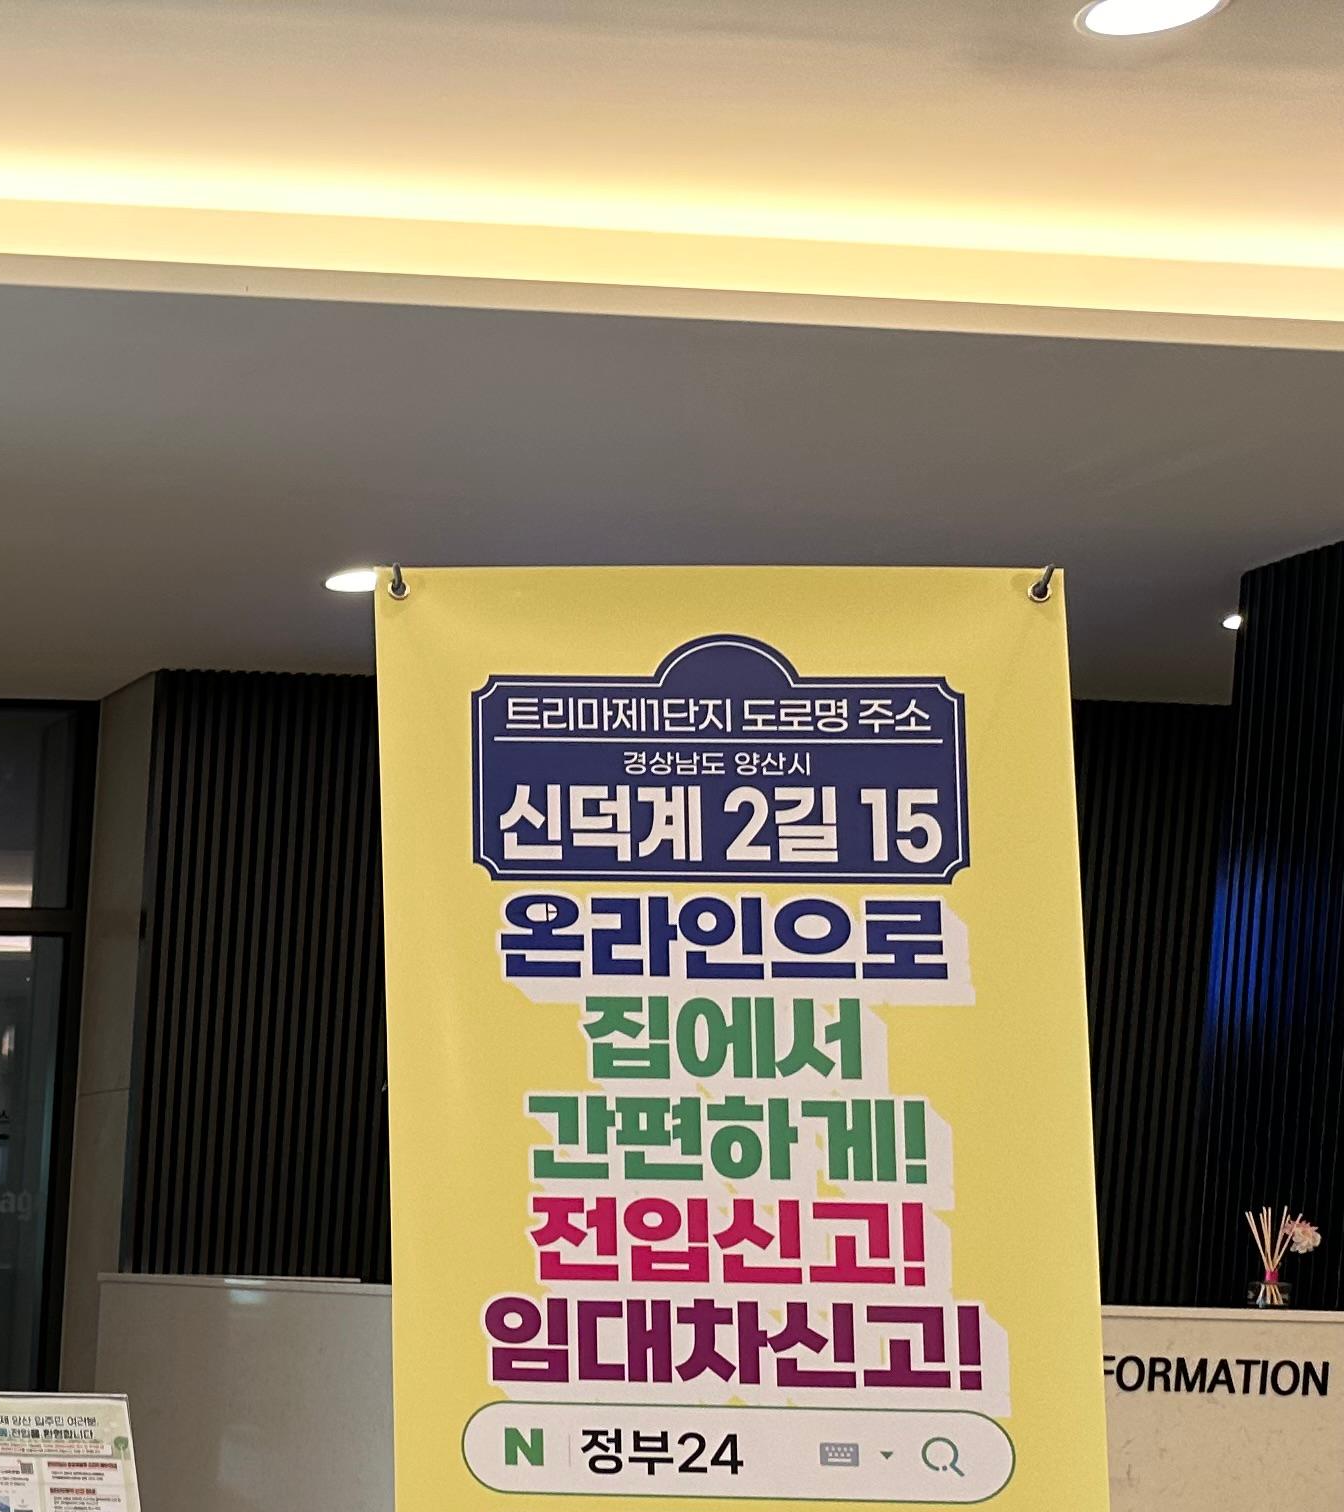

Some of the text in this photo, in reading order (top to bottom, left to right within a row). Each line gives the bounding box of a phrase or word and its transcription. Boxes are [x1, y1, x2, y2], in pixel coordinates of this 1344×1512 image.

[505, 697, 931, 733] 트리마제1단지 도로명 주소
[623, 751, 812, 776] 경상남도 양산시
[499, 784, 943, 864] 신덕계 2길 15
[501, 894, 949, 980] 온라인으로
[583, 996, 862, 1080] 집에서
[525, 1096, 928, 1184] 간편하게!
[529, 1196, 926, 1286] 전입신고!
[484, 1296, 983, 1391] 임대차신고!
[505, 1427, 544, 1466] N
[580, 1428, 744, 1476] 정부24
